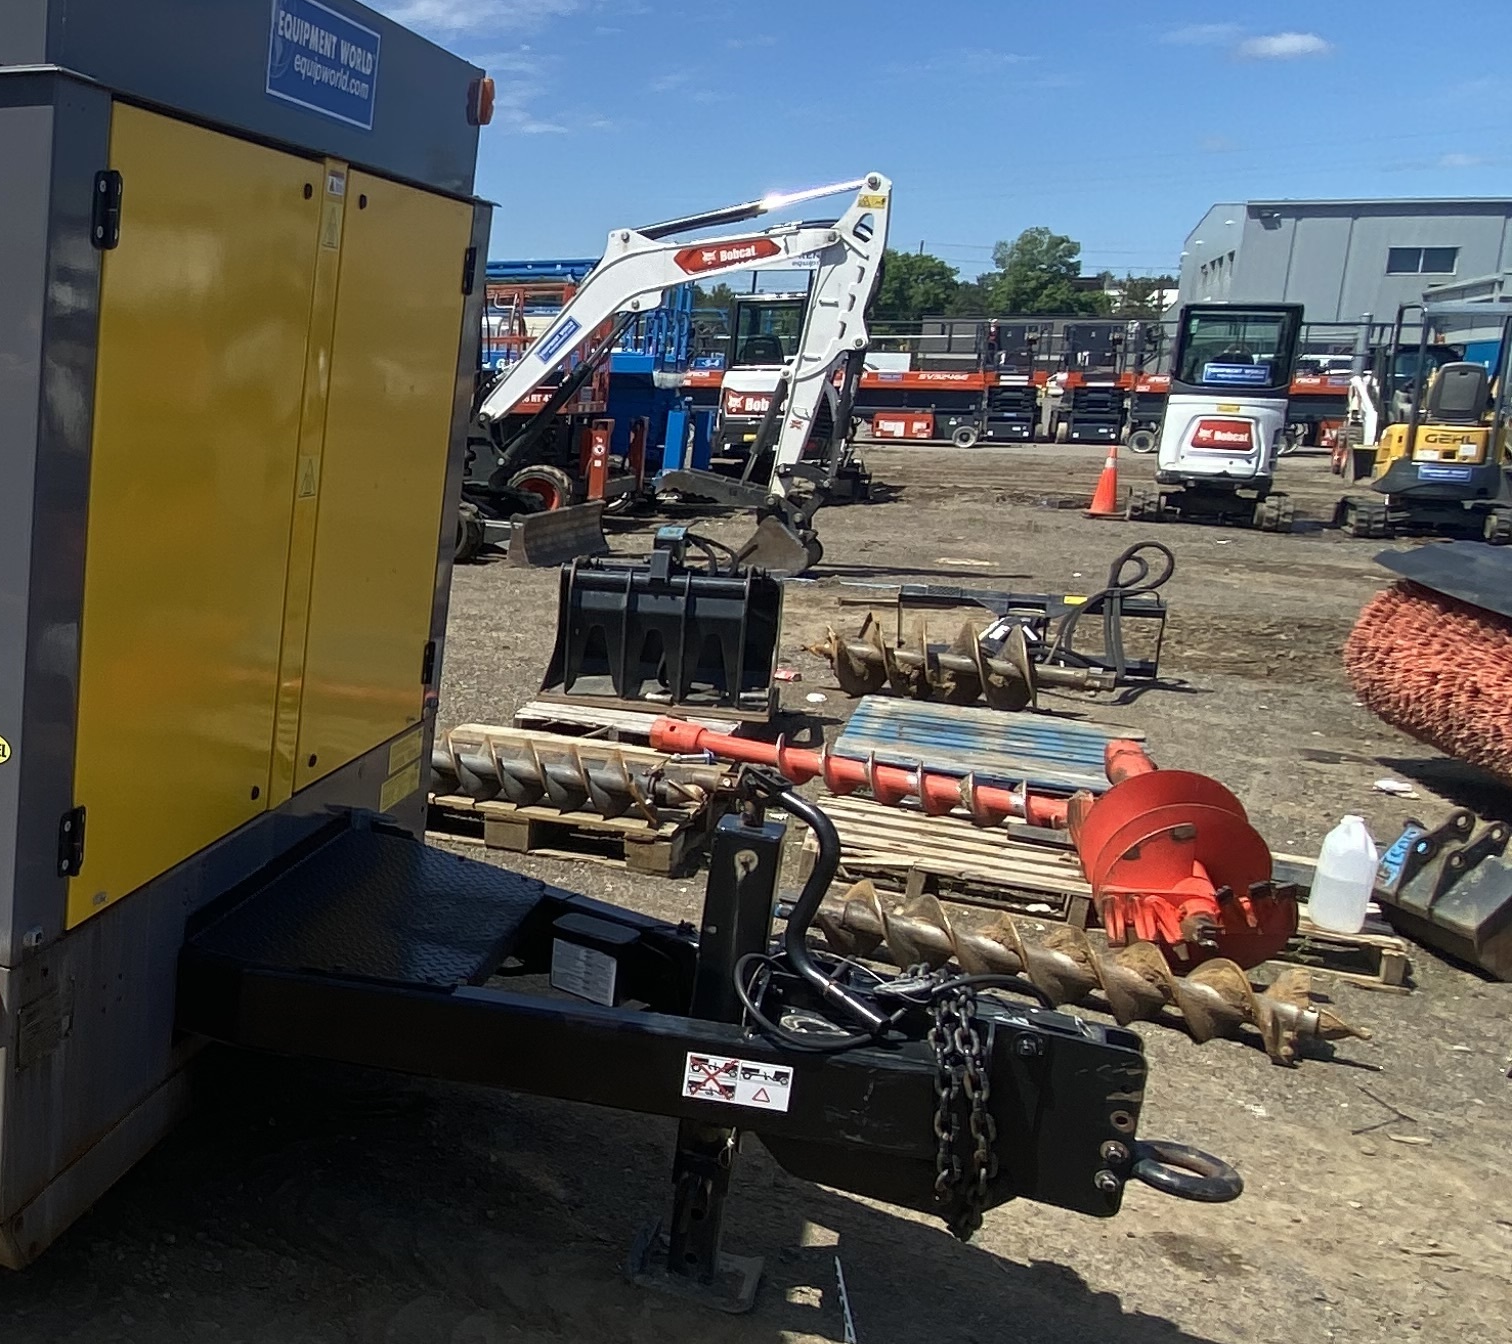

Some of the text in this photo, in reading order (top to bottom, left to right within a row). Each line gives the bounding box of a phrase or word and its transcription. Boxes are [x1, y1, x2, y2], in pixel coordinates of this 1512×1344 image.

[278, 10, 373, 75] EQUIPMENT WORLD
[294, 54, 369, 99] equipworld.com
[719, 245, 756, 262] Bobcat
[1213, 430, 1248, 442] Bobcat
[1425, 434, 1474, 444] GEHL
